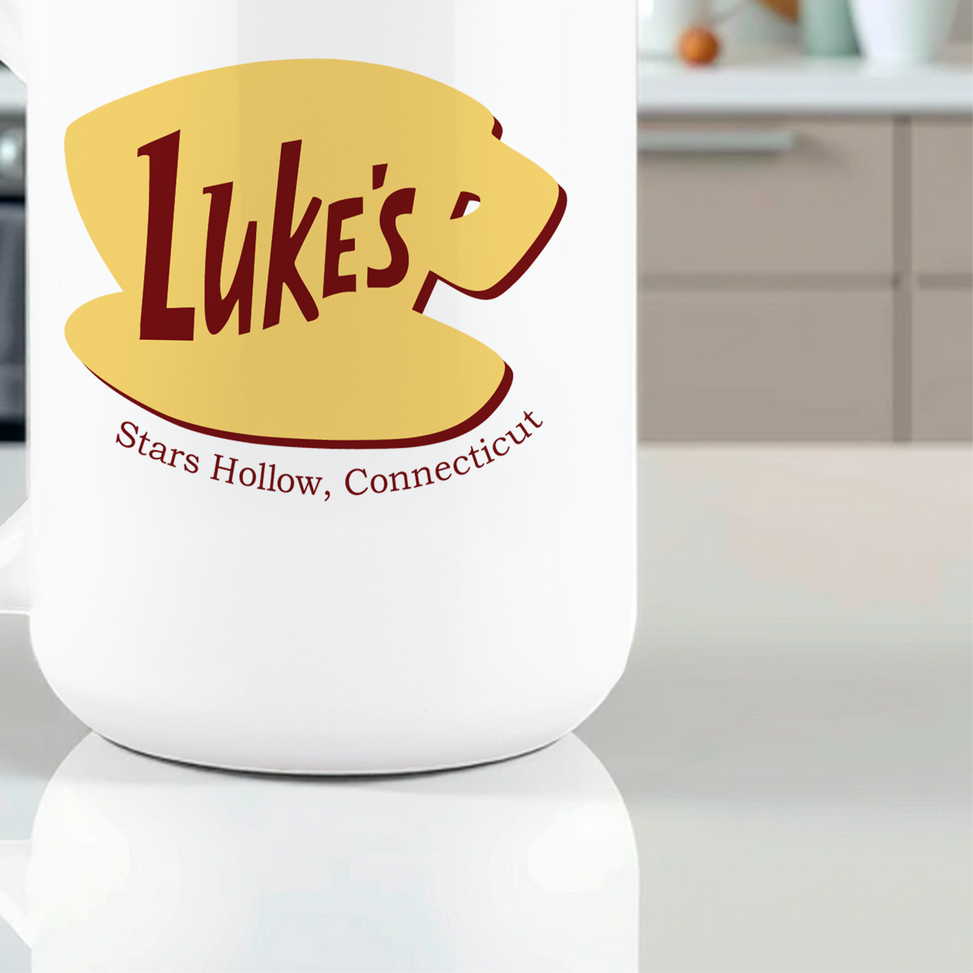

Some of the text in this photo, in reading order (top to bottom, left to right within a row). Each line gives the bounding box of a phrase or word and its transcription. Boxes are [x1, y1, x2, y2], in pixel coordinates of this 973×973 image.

[115, 410, 544, 502] Stars Hollow, Connecticut
